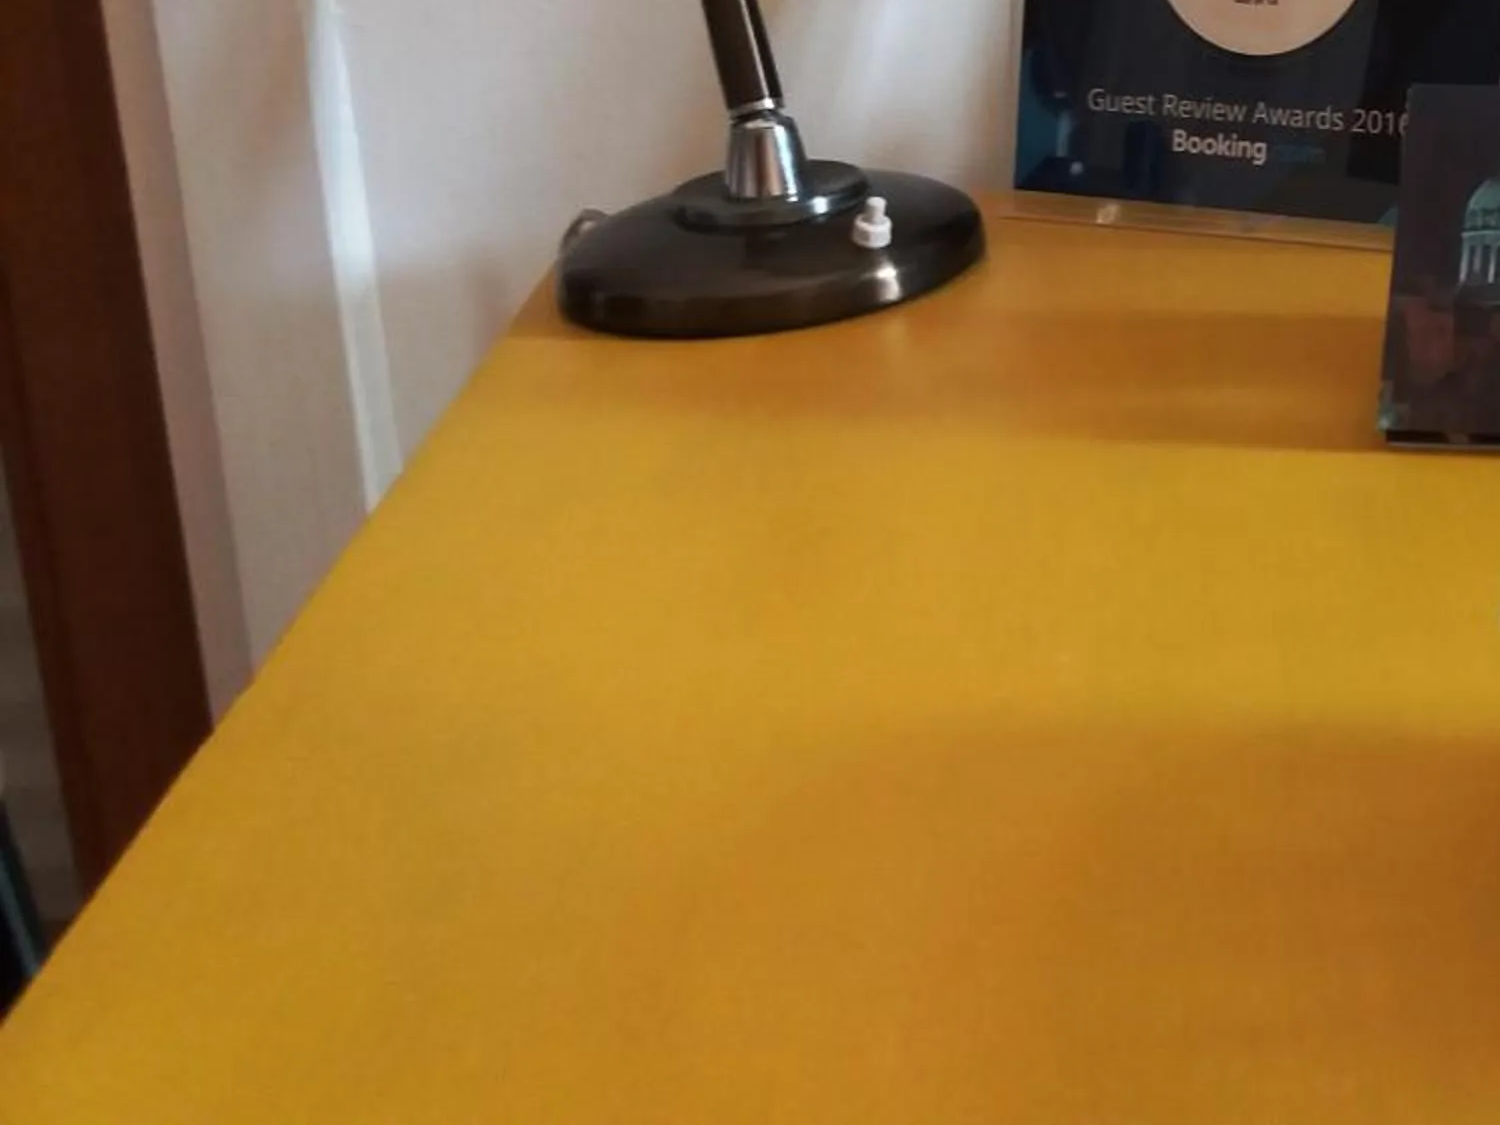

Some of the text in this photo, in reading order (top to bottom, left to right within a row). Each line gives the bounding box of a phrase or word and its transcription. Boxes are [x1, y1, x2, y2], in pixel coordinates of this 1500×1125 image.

[1087, 87, 1156, 117] Guest
[1161, 93, 1247, 124] Review
[1251, 101, 1344, 132] Awards
